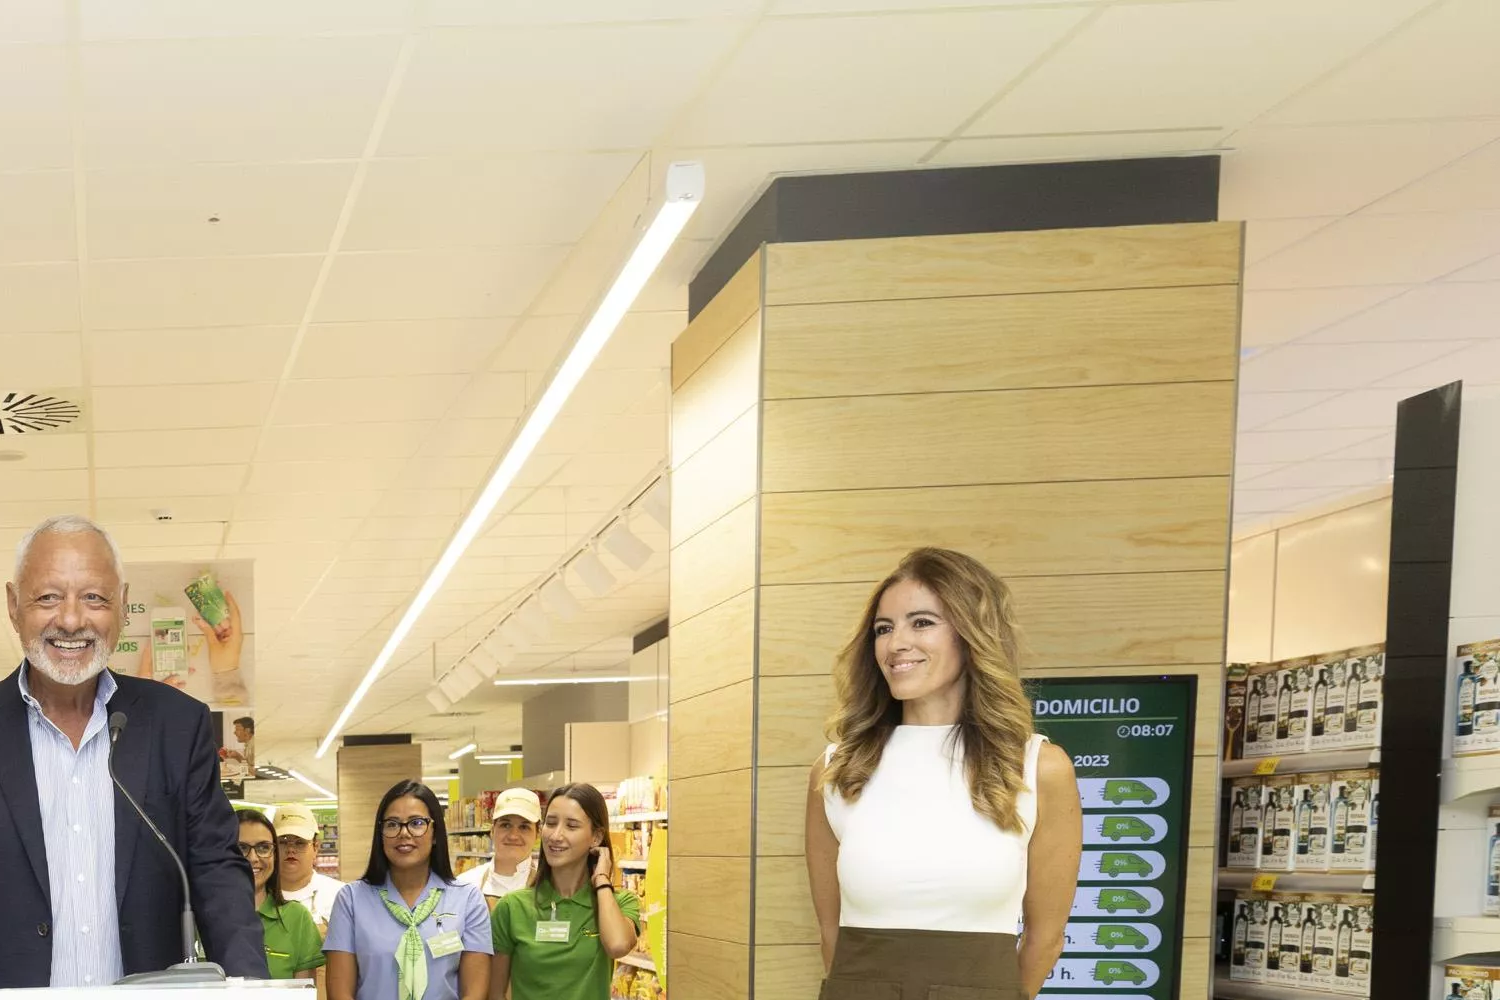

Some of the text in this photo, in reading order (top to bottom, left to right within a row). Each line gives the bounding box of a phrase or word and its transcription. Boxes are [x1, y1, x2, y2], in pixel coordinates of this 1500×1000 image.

[1035, 698, 1140, 715] DOMICILIO
[1131, 724, 1174, 736] 08:07
[1074, 755, 1110, 767] 2023
